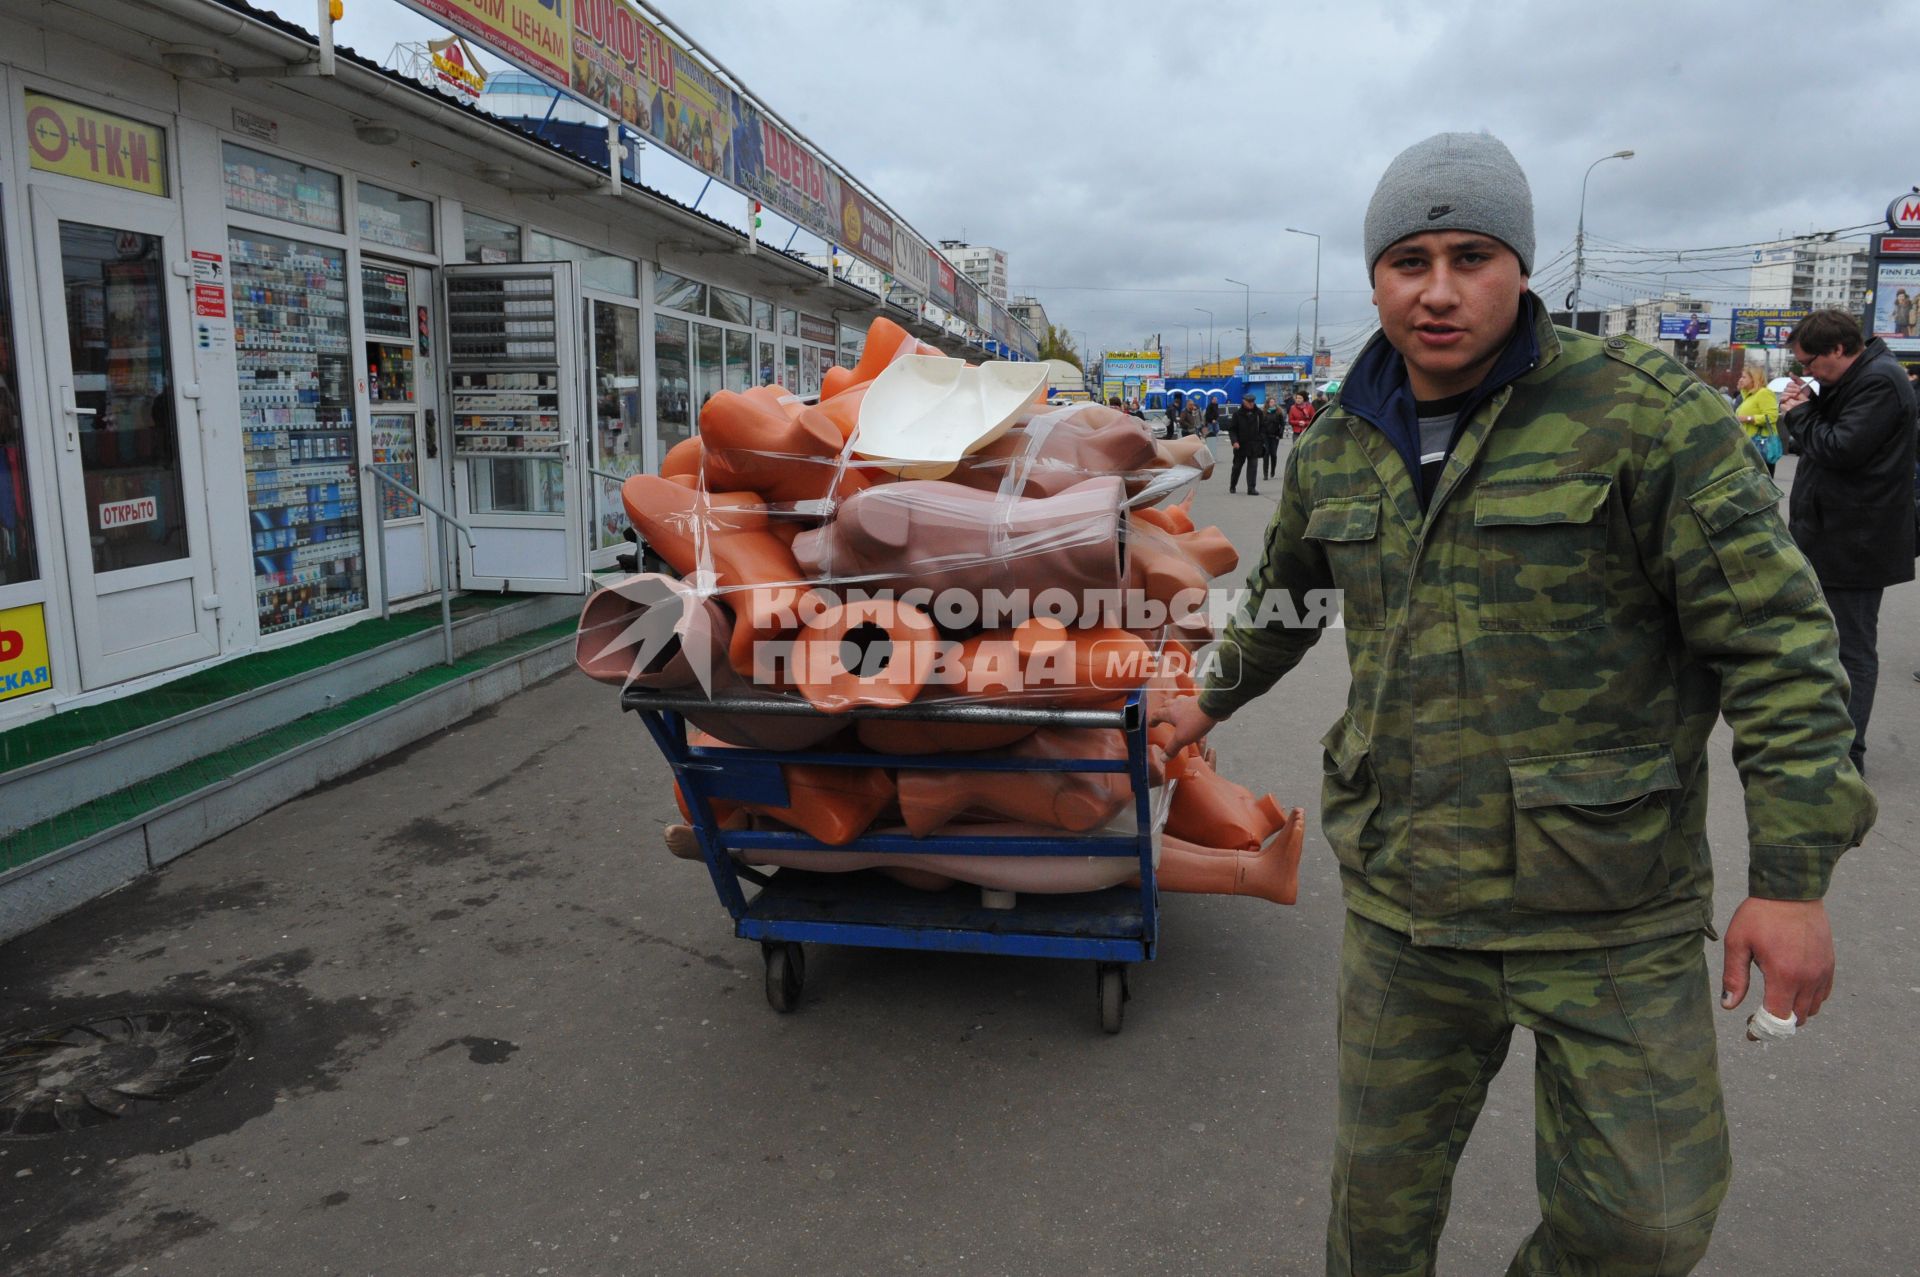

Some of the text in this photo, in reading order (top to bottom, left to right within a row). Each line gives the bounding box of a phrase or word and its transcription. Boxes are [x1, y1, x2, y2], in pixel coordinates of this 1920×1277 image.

[512, 5, 564, 60] ЦЕНАМ
[573, 0, 675, 96] КОНФЕТЫ
[27, 106, 150, 184] ОЧКИ
[762, 118, 825, 206] ЦВЕТЫ
[894, 229, 928, 285] СУМКИ
[103, 502, 154, 525] ОТКРЫТО
